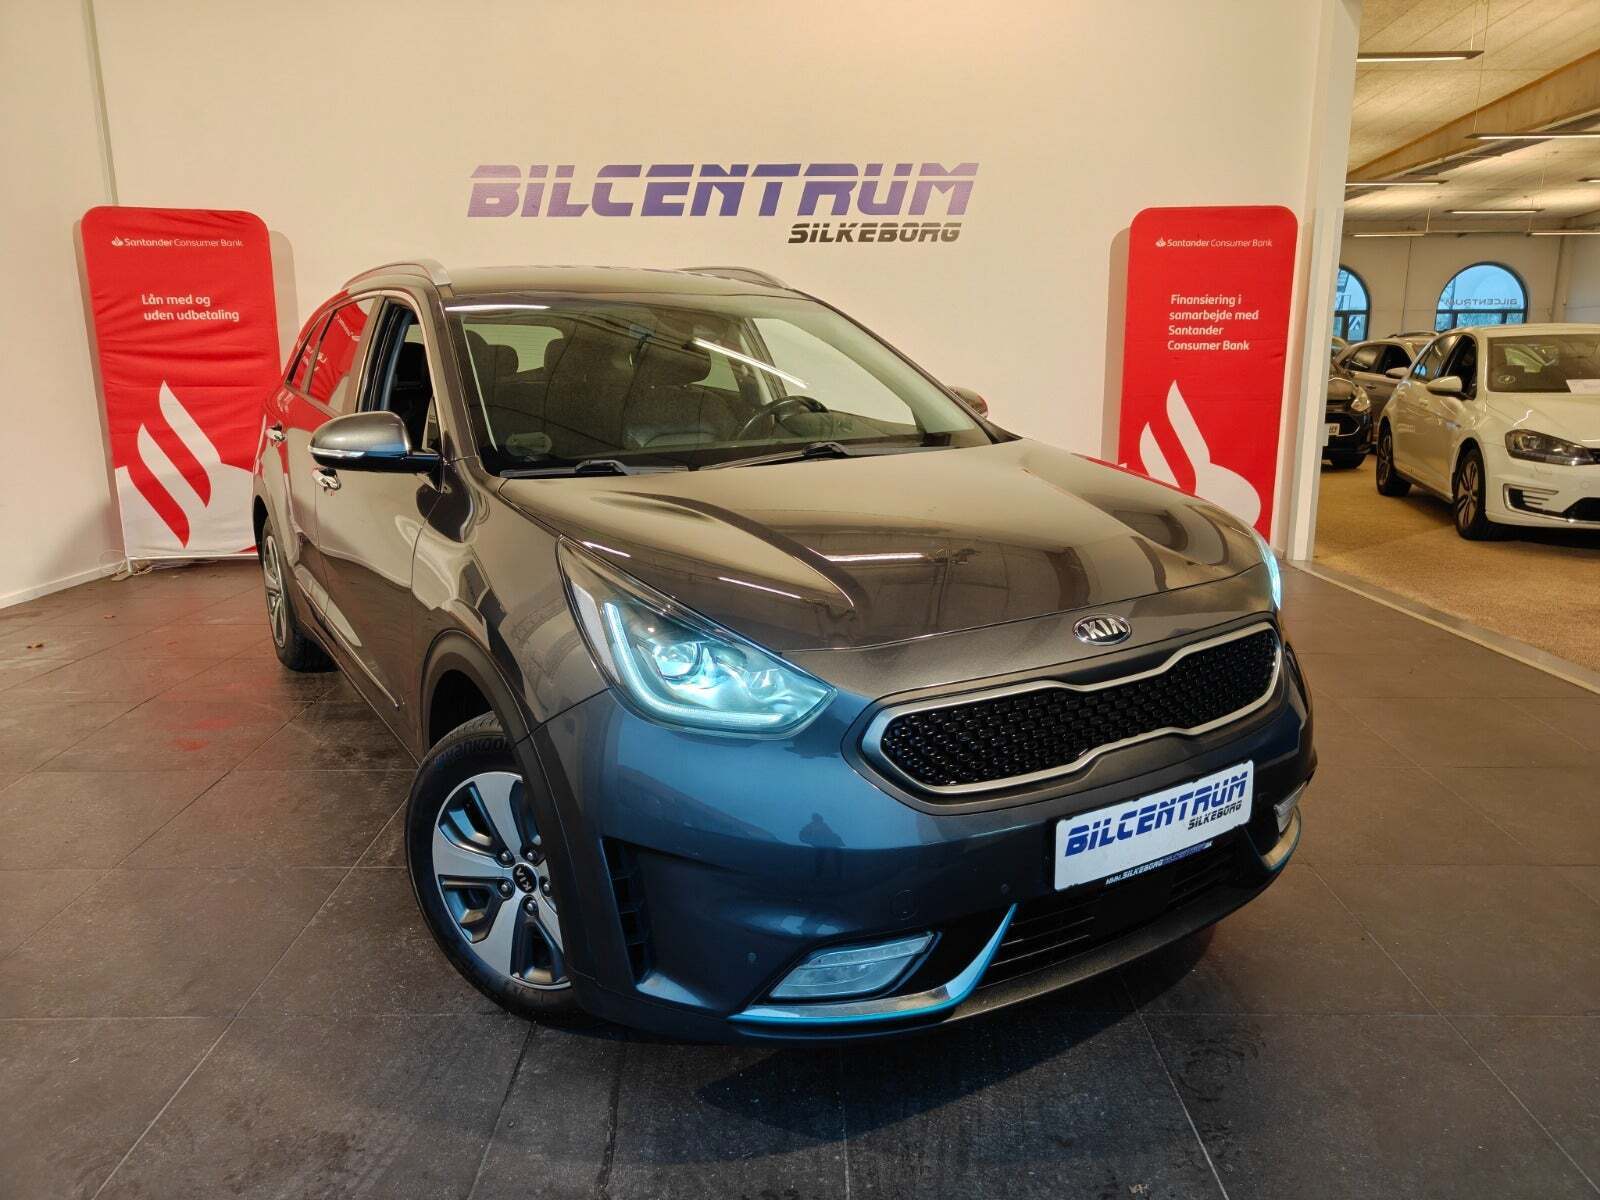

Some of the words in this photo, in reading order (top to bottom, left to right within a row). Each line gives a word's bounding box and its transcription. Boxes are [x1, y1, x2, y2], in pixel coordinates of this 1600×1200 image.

[466, 162, 979, 217] BILCENTRUM
[788, 222, 962, 243] SILKEBORG
[124, 237, 172, 247] Santander
[173, 238, 219, 247] Consumer
[220, 238, 243, 247] Bank
[1167, 239, 1210, 248] Santander
[1210, 239, 1251, 248] Consumer
[1252, 239, 1273, 248] Bank
[141, 293, 163, 305] Lån
[166, 294, 193, 305] med
[195, 296, 211, 307] og
[1170, 294, 1236, 307] Finansiering
[143, 310, 174, 320] uden
[176, 310, 240, 322] udbetaling
[1168, 310, 1232, 322] samarbejde
[1234, 310, 1259, 320] med
[1168, 325, 1223, 336] Santander
[1167, 340, 1221, 350] Consumer
[1223, 340, 1249, 351] Bank
[1081, 618, 1127, 640] KIA
[1065, 771, 1248, 857] BILCENTRUM
[1187, 800, 1242, 831] SILKEBORG
[516, 866, 532, 892] KIA
